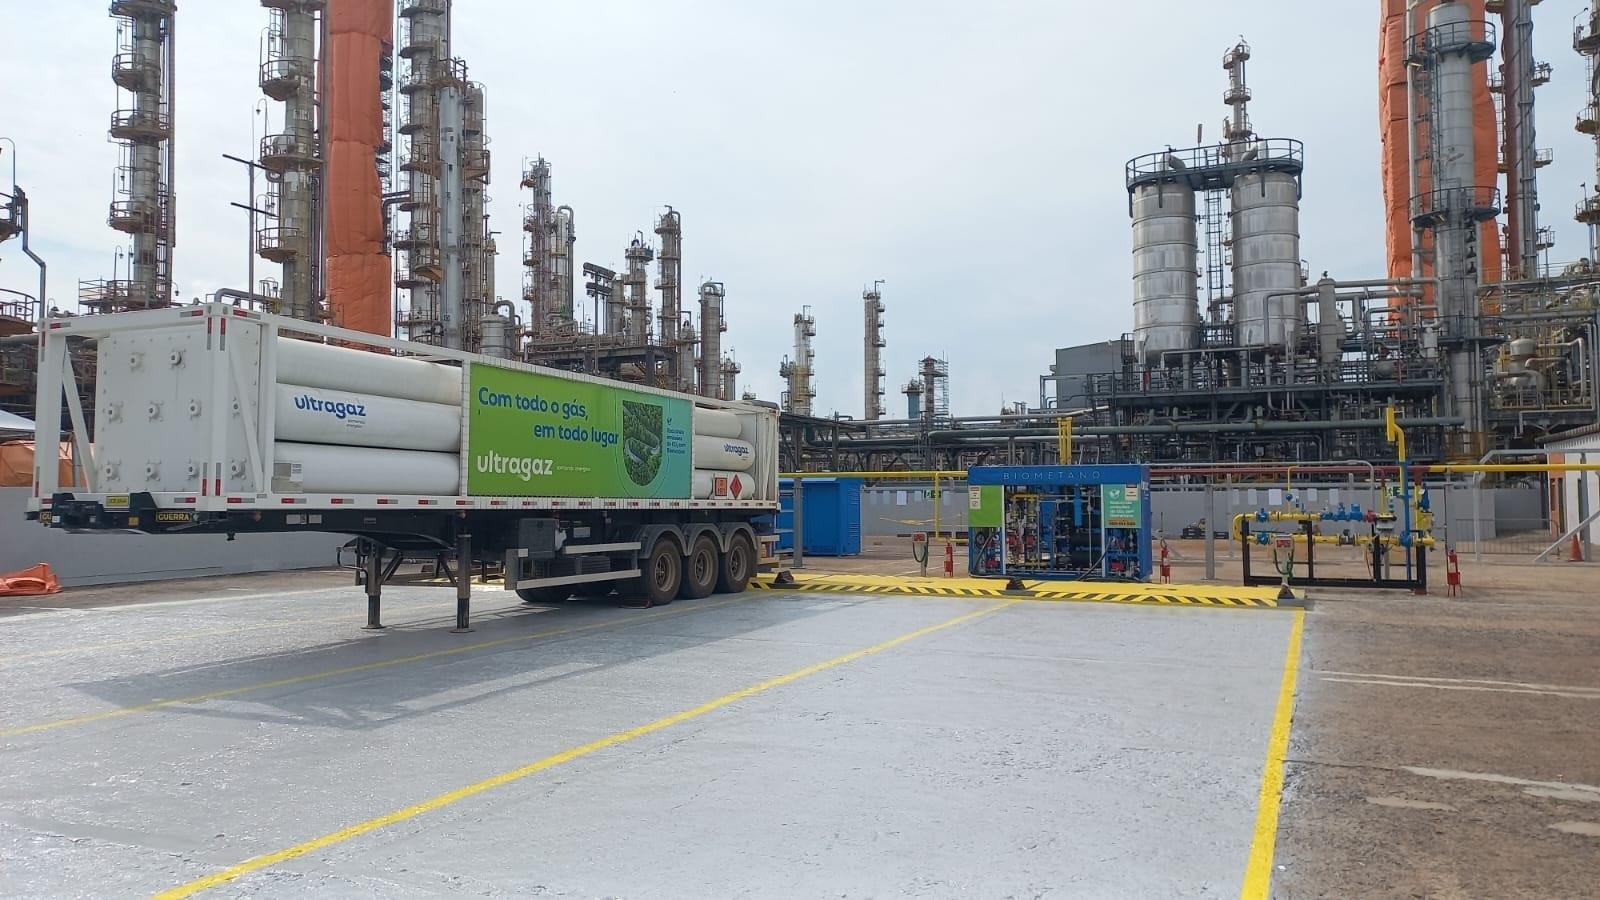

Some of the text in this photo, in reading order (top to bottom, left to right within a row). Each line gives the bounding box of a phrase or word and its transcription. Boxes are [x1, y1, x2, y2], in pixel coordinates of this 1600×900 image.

[294, 394, 366, 419] ultragaz
[478, 387, 589, 420] Com todo o gás,
[534, 424, 619, 448] em todo lugar
[723, 443, 749, 456] ultragaz
[477, 450, 553, 481] ultragaz
[1003, 471, 1100, 480] BIOMETANO
[158, 512, 190, 522] GUERRA
